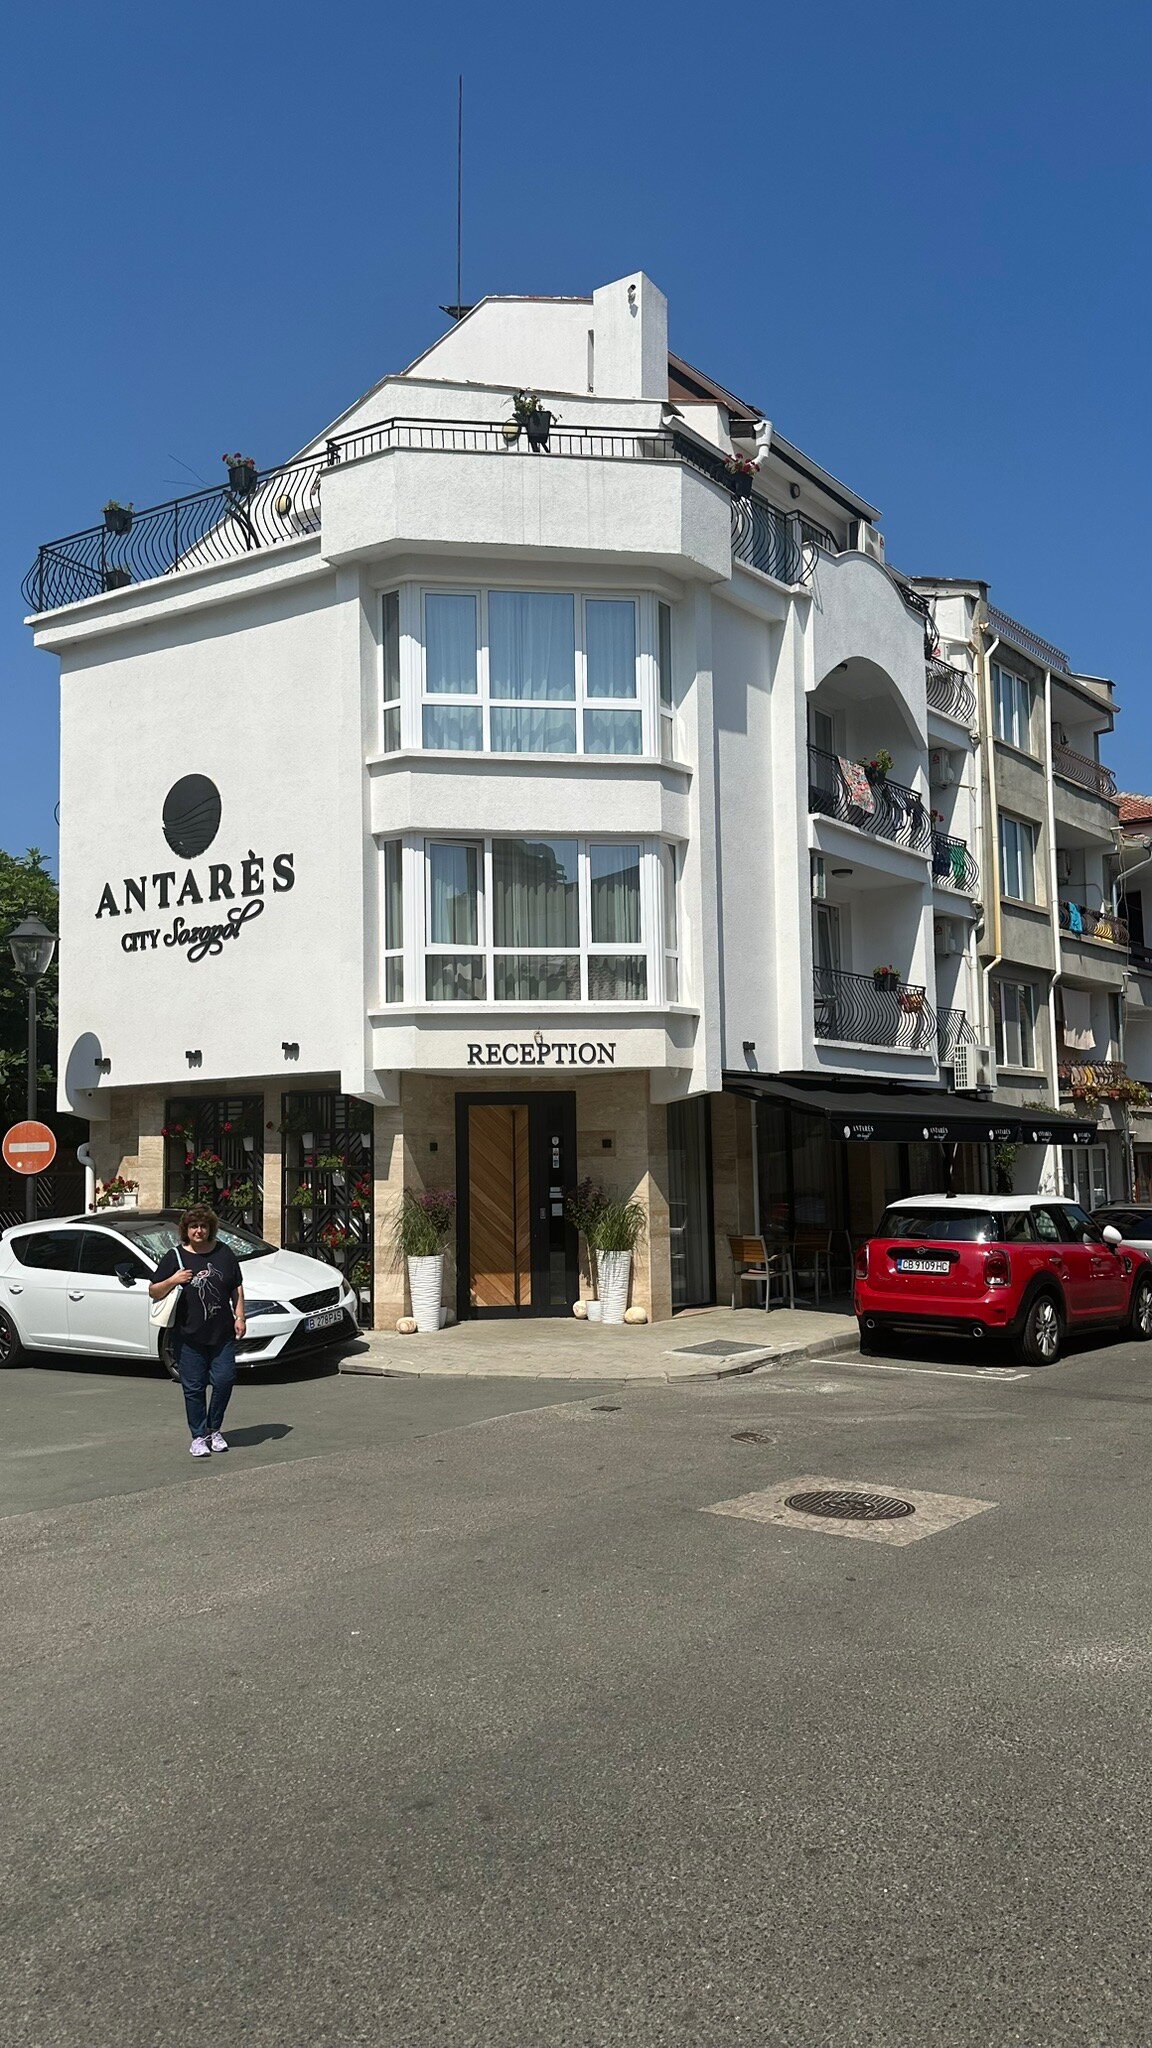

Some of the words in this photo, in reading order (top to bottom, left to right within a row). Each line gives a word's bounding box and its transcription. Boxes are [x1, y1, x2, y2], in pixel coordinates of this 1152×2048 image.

[95, 849, 296, 919] ANTARÈS
[121, 929, 160, 953] CITY
[163, 899, 265, 963] Sozopol
[467, 1042, 617, 1065] RECEPTION
